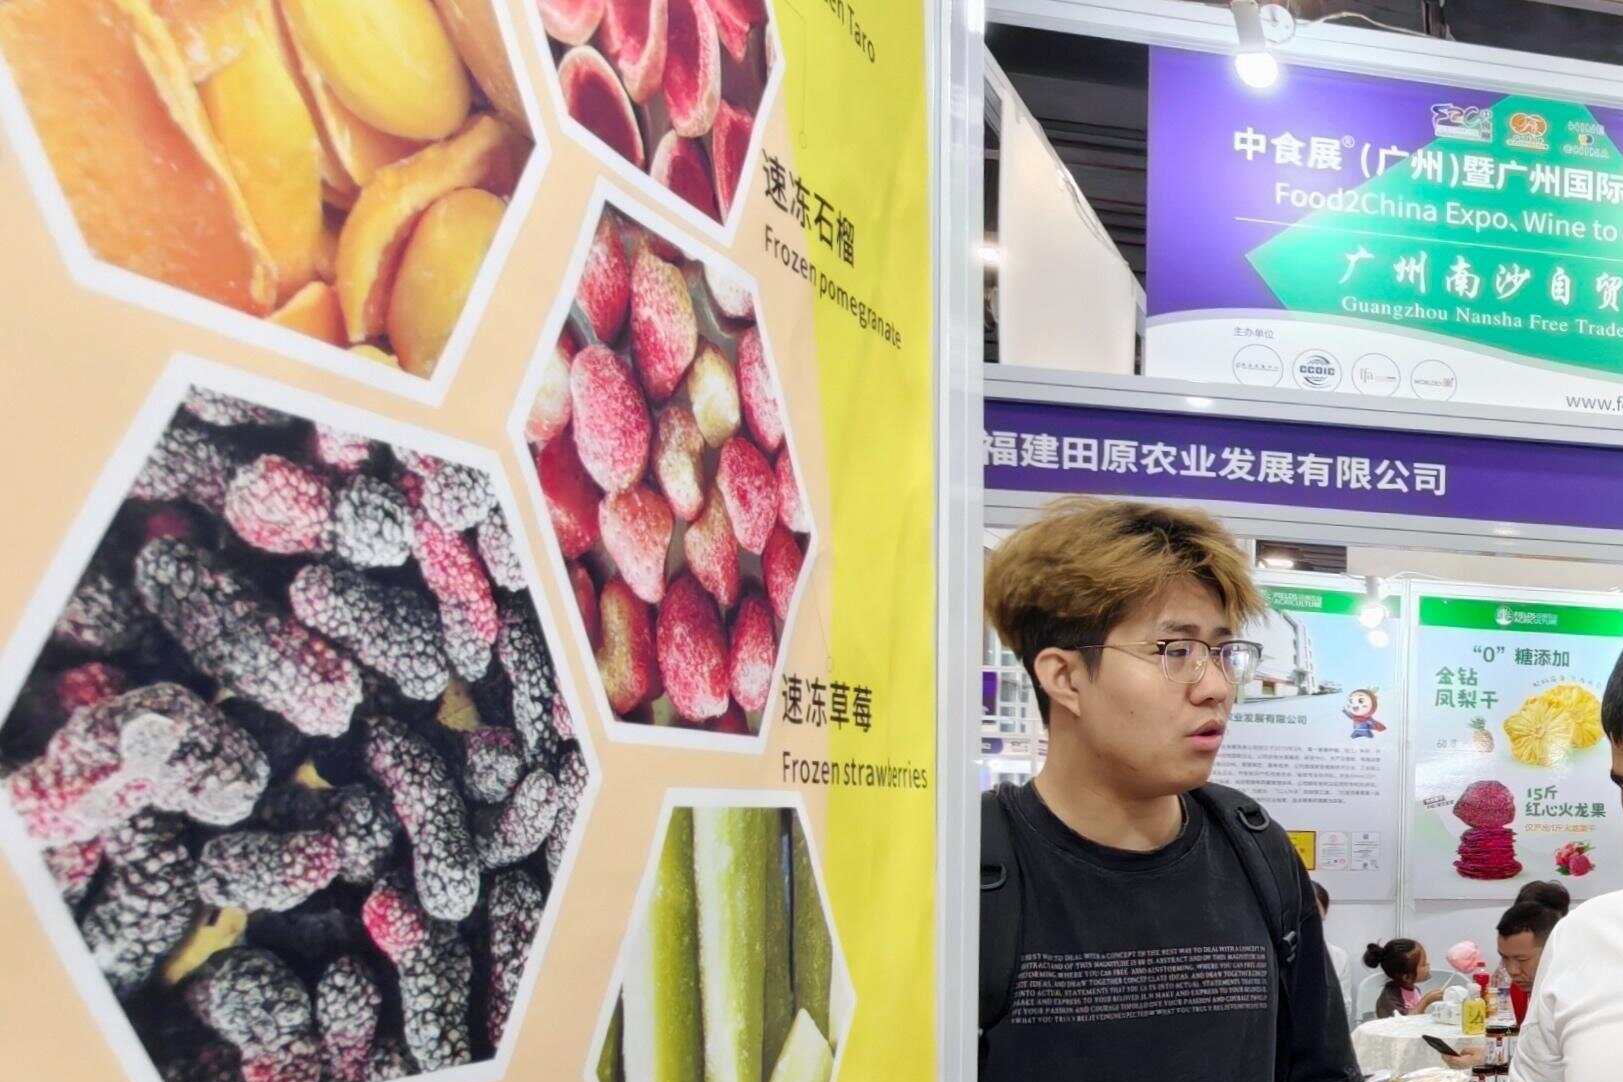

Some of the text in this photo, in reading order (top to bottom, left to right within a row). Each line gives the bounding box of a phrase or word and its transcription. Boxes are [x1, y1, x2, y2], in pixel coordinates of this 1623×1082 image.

[848, 8, 876, 64] Taro
[761, 148, 855, 269] 速冻石榴
[1275, 182, 1438, 223] Food2China
[1523, 211, 1587, 238] Wine
[1593, 221, 1618, 242] to
[764, 225, 902, 350] Frozen pomegranate
[1341, 296, 1448, 323] Guangzhou
[1456, 306, 1523, 329] Nansha
[1529, 313, 1569, 333] Free
[984, 430, 1447, 496] 福建田原农业发展有限公司
[1435, 666, 1479, 687] 金钻
[1514, 648, 1570, 668] 糖添加
[782, 673, 873, 733] 速冻草莓
[782, 752, 928, 789] Frozen strawberries
[1525, 801, 1606, 818] 红心火龙果
